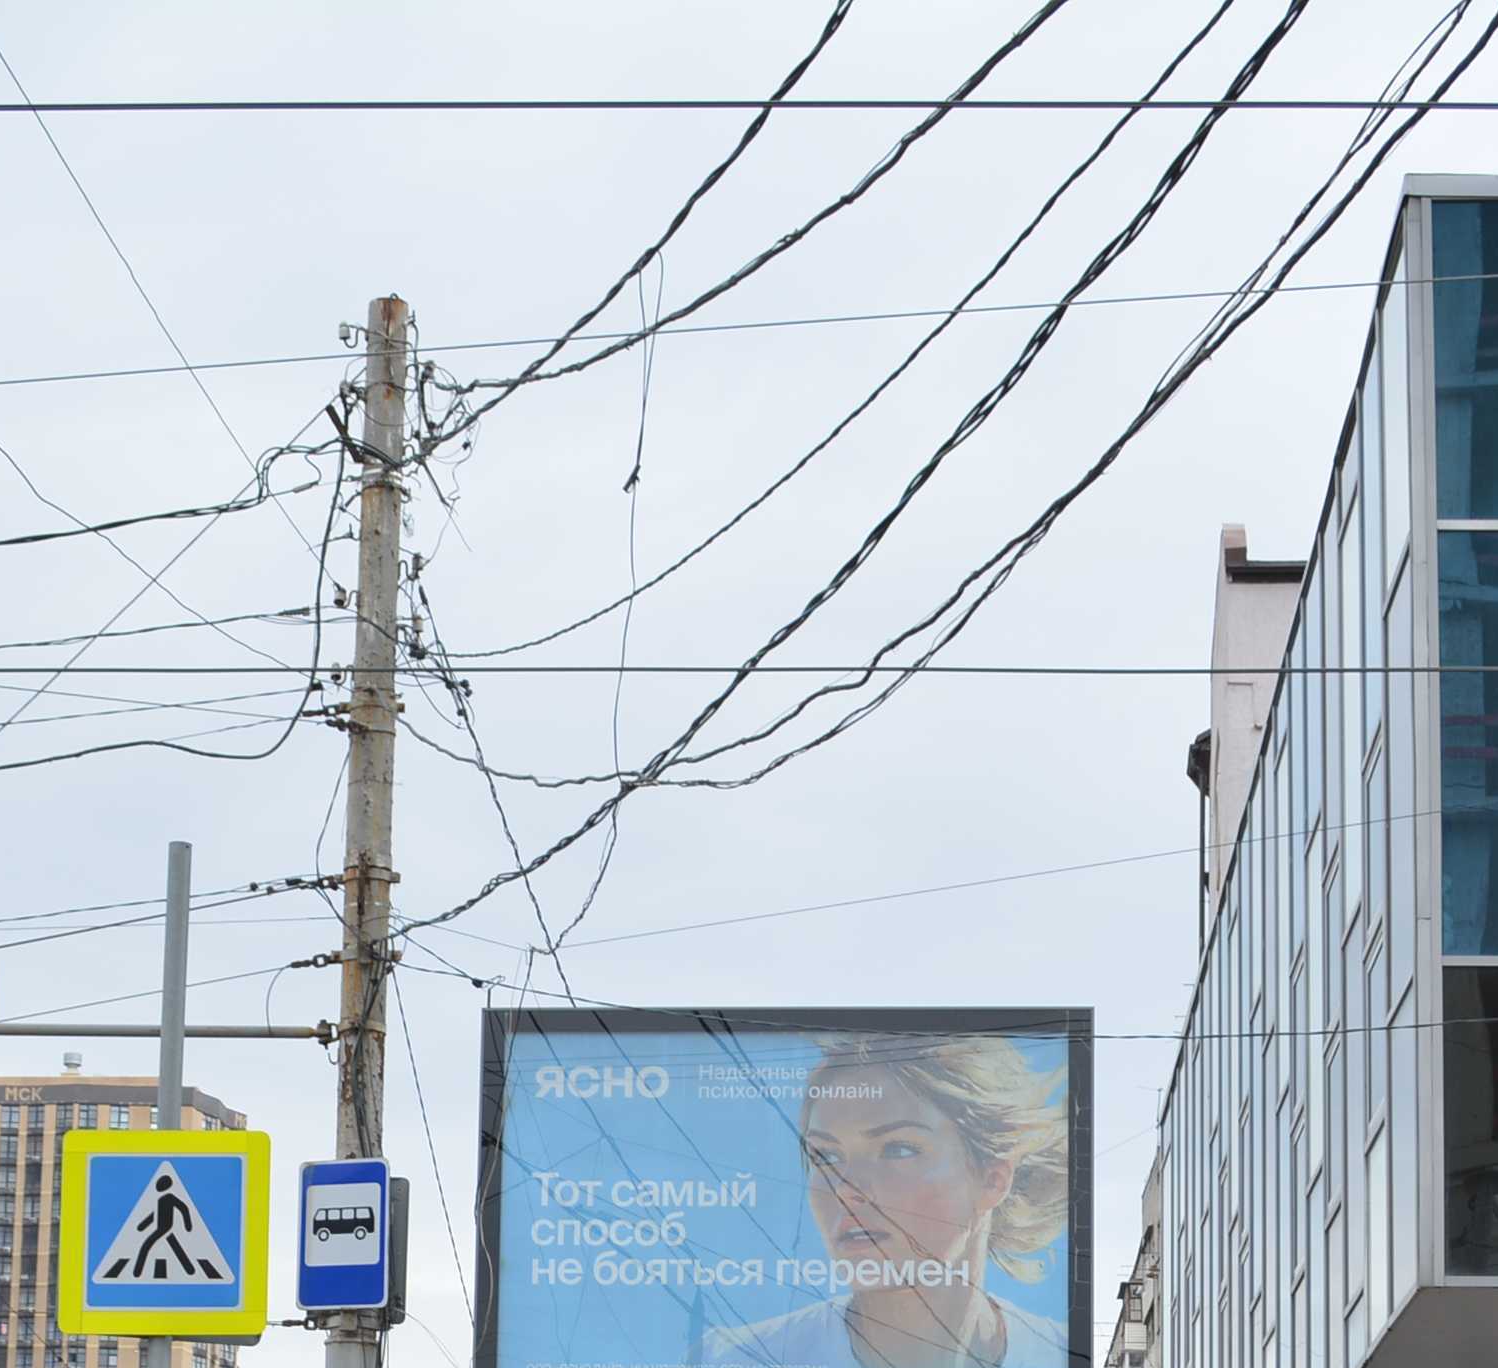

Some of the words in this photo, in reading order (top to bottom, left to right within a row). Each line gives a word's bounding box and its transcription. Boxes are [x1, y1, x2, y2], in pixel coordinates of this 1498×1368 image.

[535, 1066, 670, 1099] ЯСНО
[698, 1063, 808, 1082] Надёжные
[698, 1083, 803, 1100] психологи
[808, 1082, 883, 1100] онлайн
[532, 1172, 603, 1208] Тот
[611, 1171, 757, 1208] самый
[532, 1211, 687, 1247] способ
[532, 1257, 584, 1286] не
[594, 1250, 764, 1287] бояться
[776, 1257, 970, 1294] перемен
